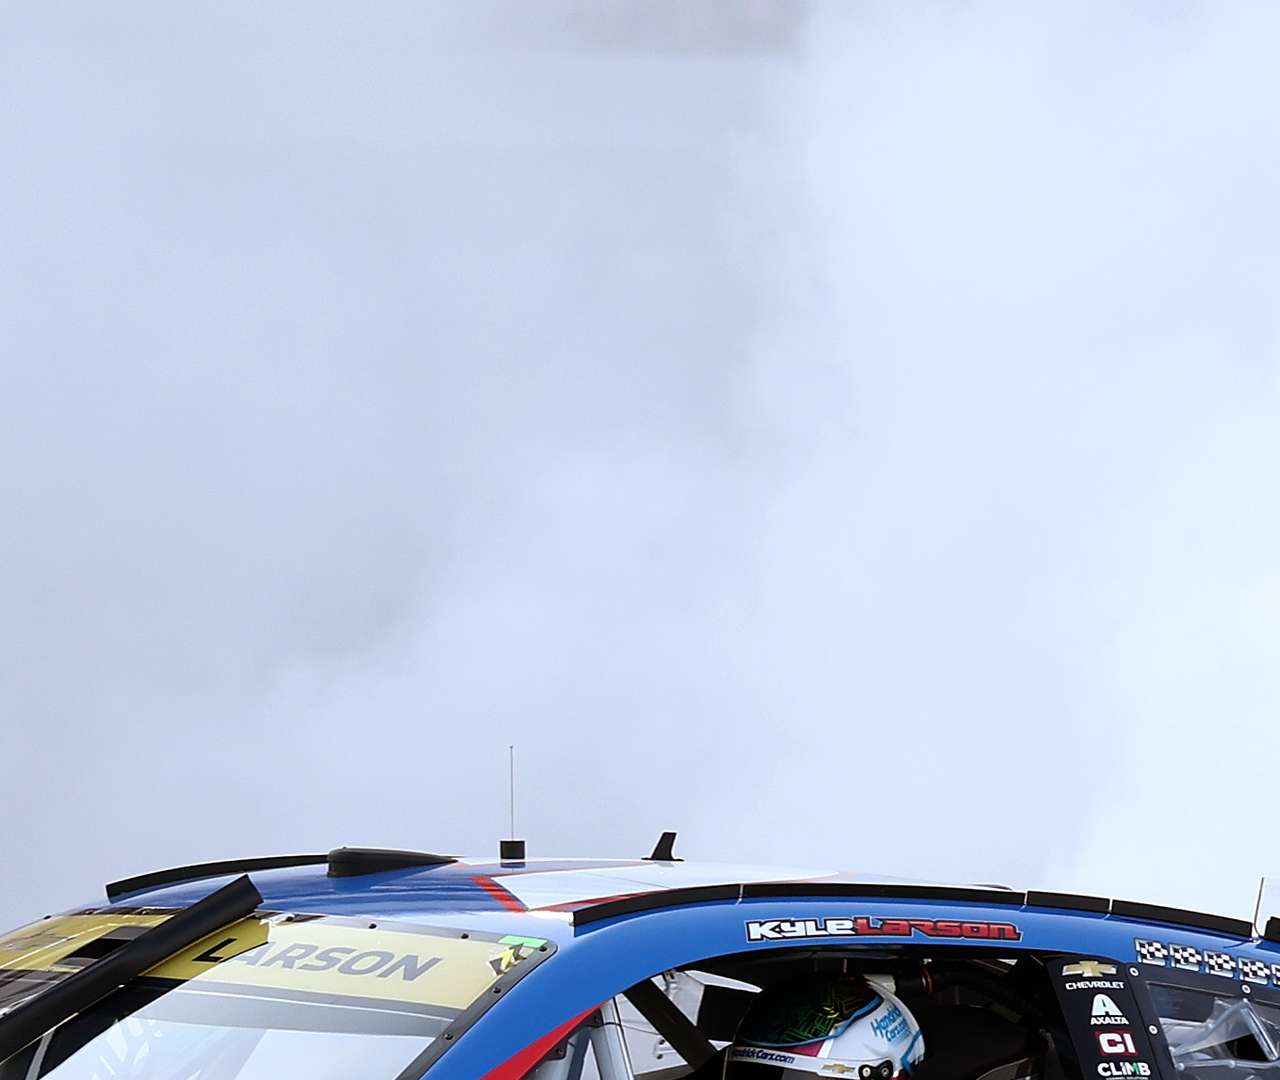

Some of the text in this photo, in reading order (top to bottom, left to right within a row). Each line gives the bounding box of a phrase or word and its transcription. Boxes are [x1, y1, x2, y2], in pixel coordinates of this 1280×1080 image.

[192, 938, 442, 983] LARSON
[1065, 981, 1124, 990] CHEVROLET
[1090, 1017, 1129, 1025] AXALTA
